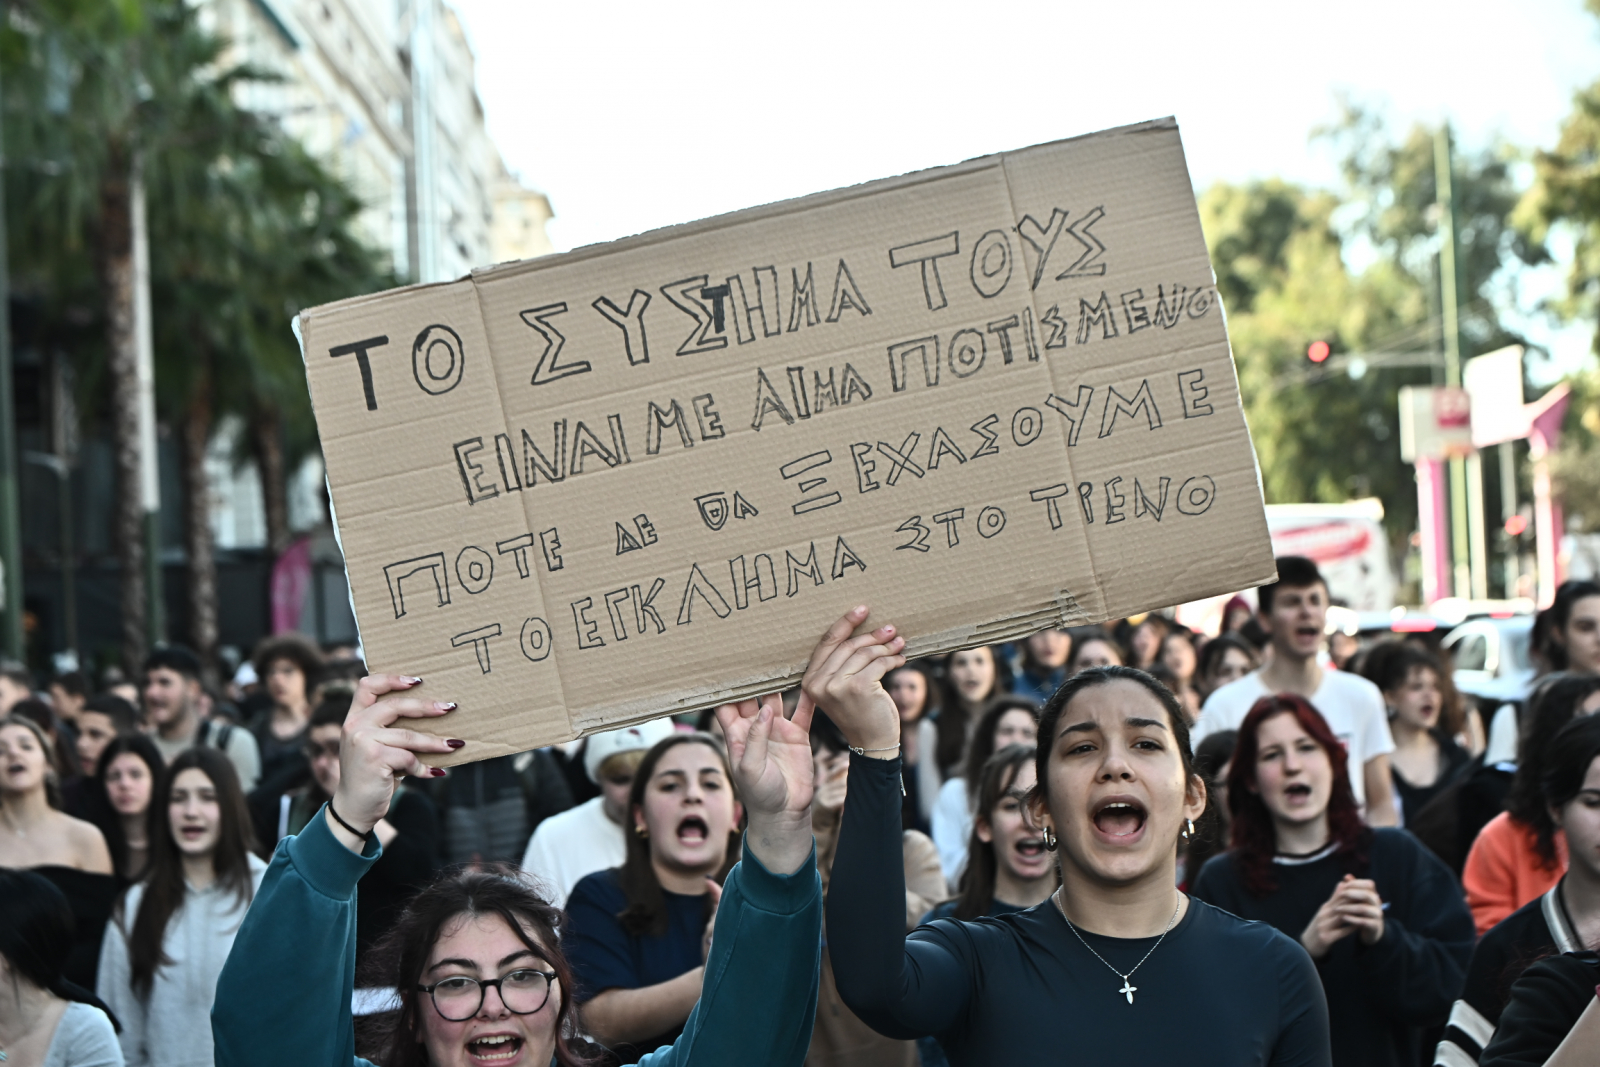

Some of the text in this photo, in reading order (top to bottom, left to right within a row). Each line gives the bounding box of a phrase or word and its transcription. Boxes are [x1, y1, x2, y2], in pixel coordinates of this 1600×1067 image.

[329, 323, 464, 411] ΤΟ
[889, 206, 1106, 311] ΤΟΥΣ
[453, 283, 1215, 506] ΕΙΝΑΙ ΜΕ ΑΙΜΑ ΠΟΤΙΣΜΕΝΟ
[383, 527, 564, 619] ΠΟΤΕ
[615, 513, 659, 556] ΔΕ
[451, 616, 553, 675] ΤΟ
[571, 535, 867, 651] ΕΓΚΛΗΜΑ
[894, 505, 1007, 553] ΣΤΟ
